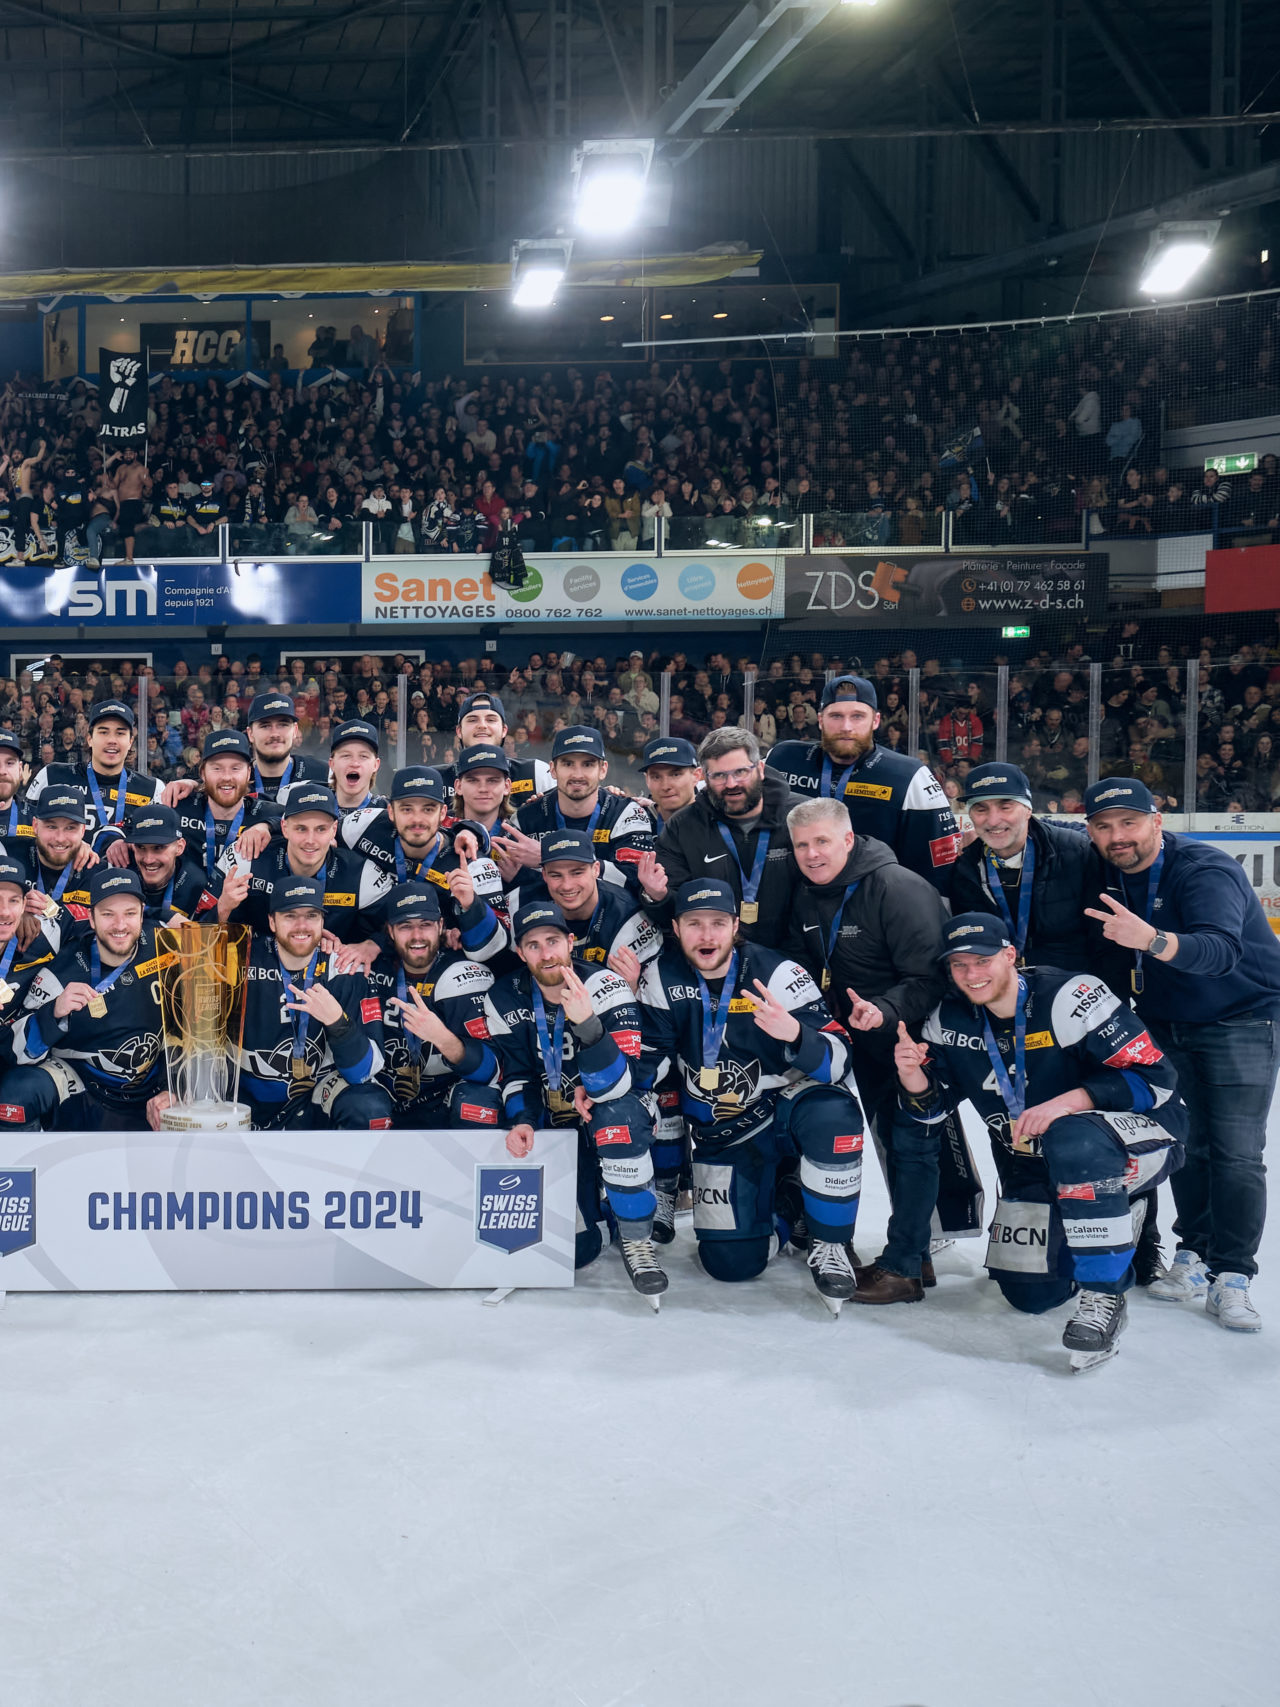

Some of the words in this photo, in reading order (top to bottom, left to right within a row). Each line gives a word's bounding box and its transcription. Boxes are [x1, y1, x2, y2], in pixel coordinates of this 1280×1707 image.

[170, 330, 240, 364] HCC
[1007, 561, 1042, 570] Peinture
[165, 586, 214, 596] Compagnie
[374, 571, 496, 602] Sanet
[804, 570, 880, 610] ZDS
[979, 581, 997, 591] +41
[1000, 580, 1014, 593] (0)
[1018, 580, 1030, 591] 79
[1034, 580, 1053, 591] 462
[1057, 580, 1070, 590] 58
[1074, 580, 1085, 590] 61
[165, 599, 193, 607] depuis
[196, 599, 214, 607] 1921
[979, 594, 1084, 610] www.z-d-s.ch
[375, 605, 496, 618] NETTOYAGES
[505, 609, 540, 618] 0800
[545, 609, 571, 618] 762
[576, 608, 603, 618] 762
[625, 607, 772, 618] www.sanet-nettoyages.ch
[789, 775, 819, 790] BCN
[370, 845, 395, 864] BCN
[488, 895, 502, 905] T19
[258, 967, 283, 980] BCN
[1070, 984, 1109, 1019] TISSOT
[614, 1008, 628, 1019] T19
[1098, 1023, 1115, 1039] T19
[957, 1033, 988, 1051] BCN
[613, 1164, 638, 1173] Calame
[825, 1176, 848, 1185] Didier
[87, 1190, 310, 1231] CHAMPIONS
[325, 1189, 423, 1230] 2024
[481, 1194, 538, 1212] SWISS
[479, 1211, 541, 1231] LEAGUE
[1073, 1225, 1109, 1233] Calame
[1002, 1227, 1046, 1246] BCN
